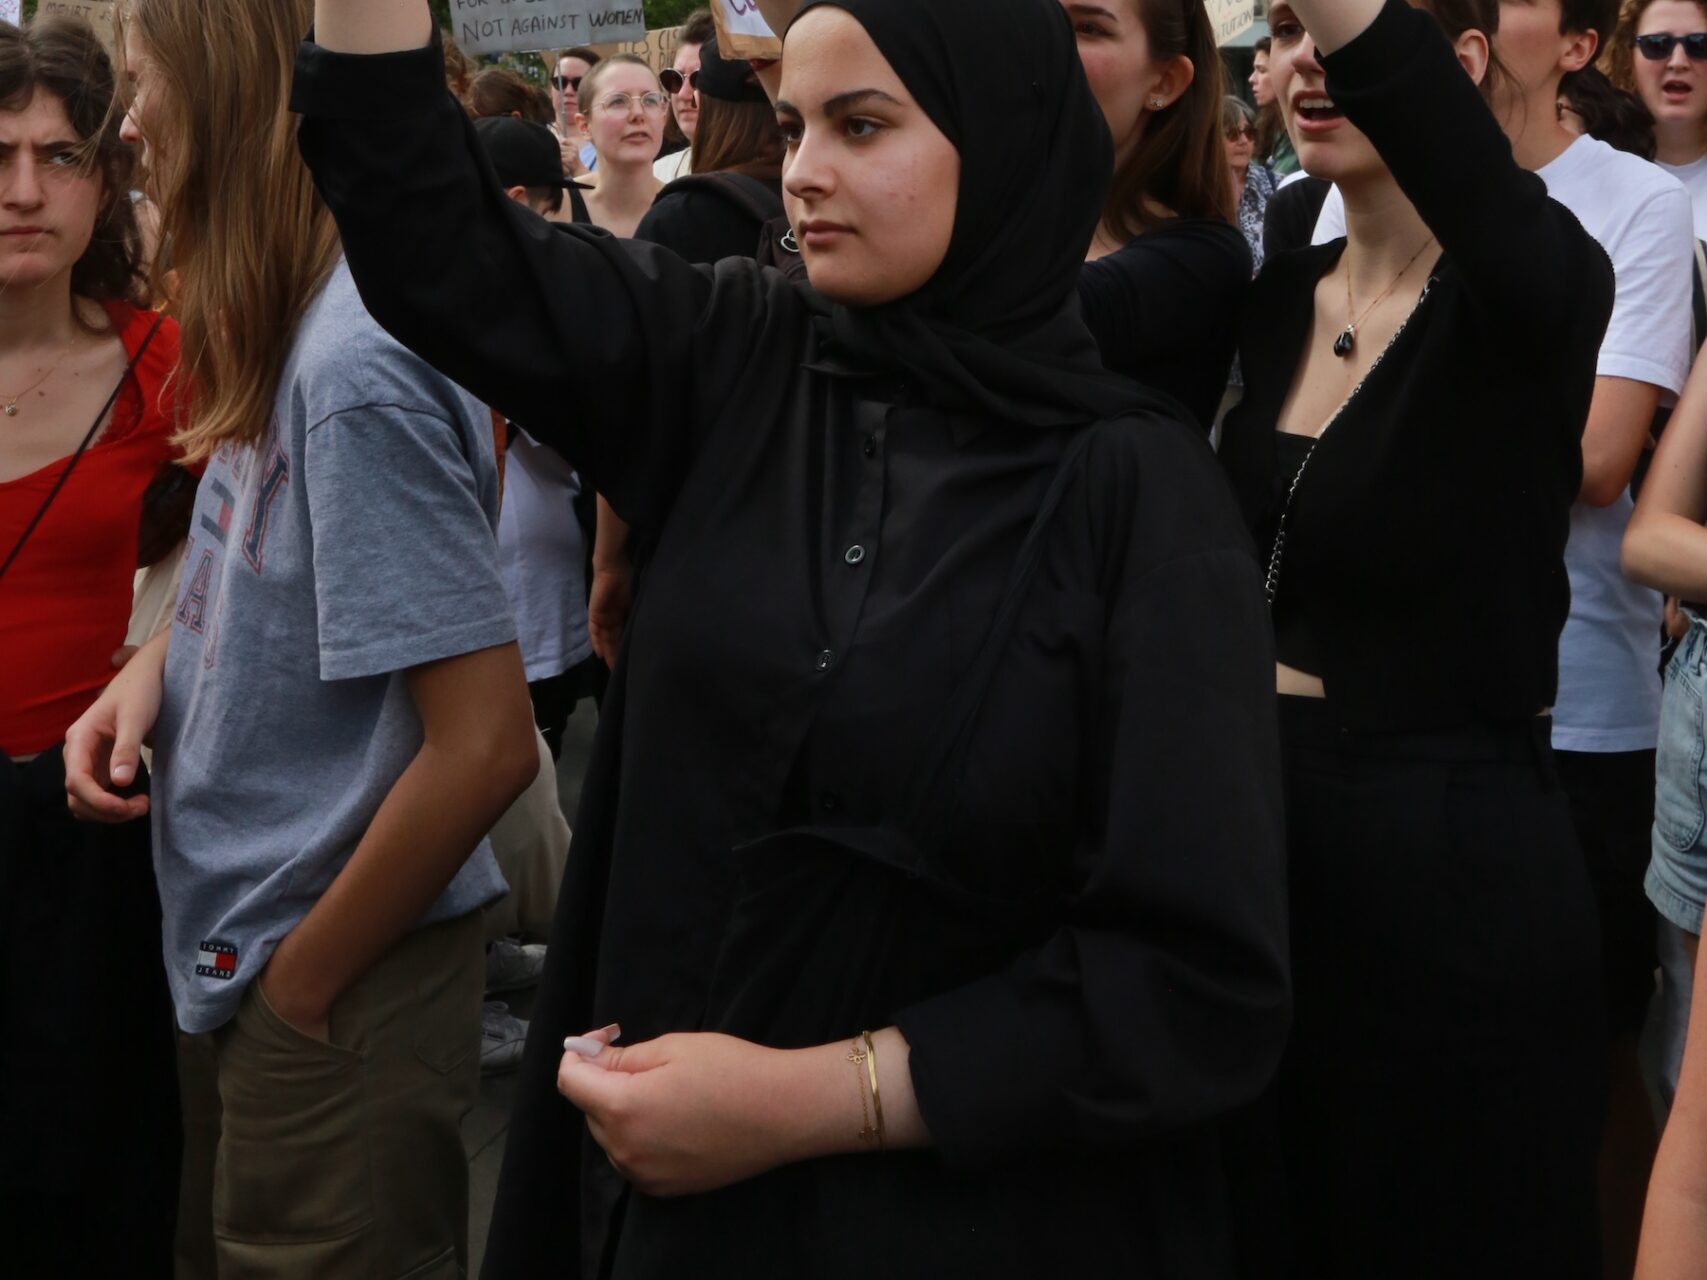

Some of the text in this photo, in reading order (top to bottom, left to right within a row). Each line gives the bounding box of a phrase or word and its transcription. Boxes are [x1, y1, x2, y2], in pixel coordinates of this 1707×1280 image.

[463, 18, 504, 45] NOT
[589, 7, 643, 28] WOMEN
[203, 943, 234, 953] TOMMY
[198, 967, 231, 977] JEANS
